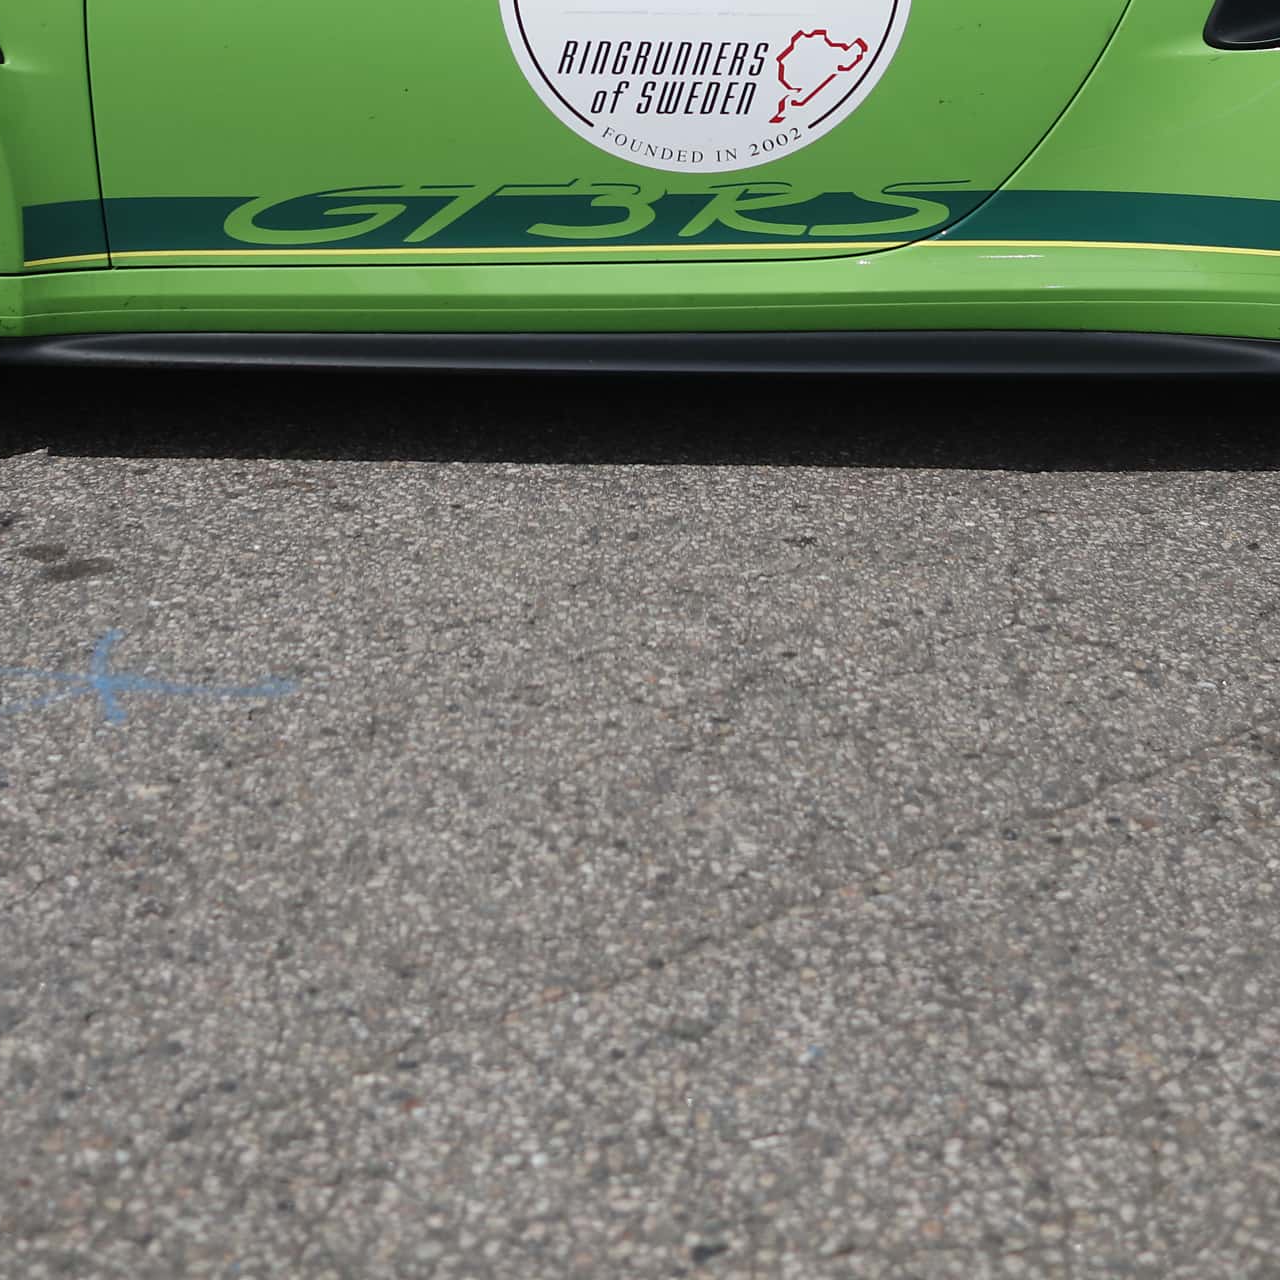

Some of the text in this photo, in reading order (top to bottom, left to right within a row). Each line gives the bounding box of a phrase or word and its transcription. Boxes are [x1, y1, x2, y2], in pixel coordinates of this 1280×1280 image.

[557, 40, 769, 76] RINGRUNNERS
[590, 81, 757, 115] of SWEDEN
[601, 126, 803, 163] FOUNDED IN 2002
